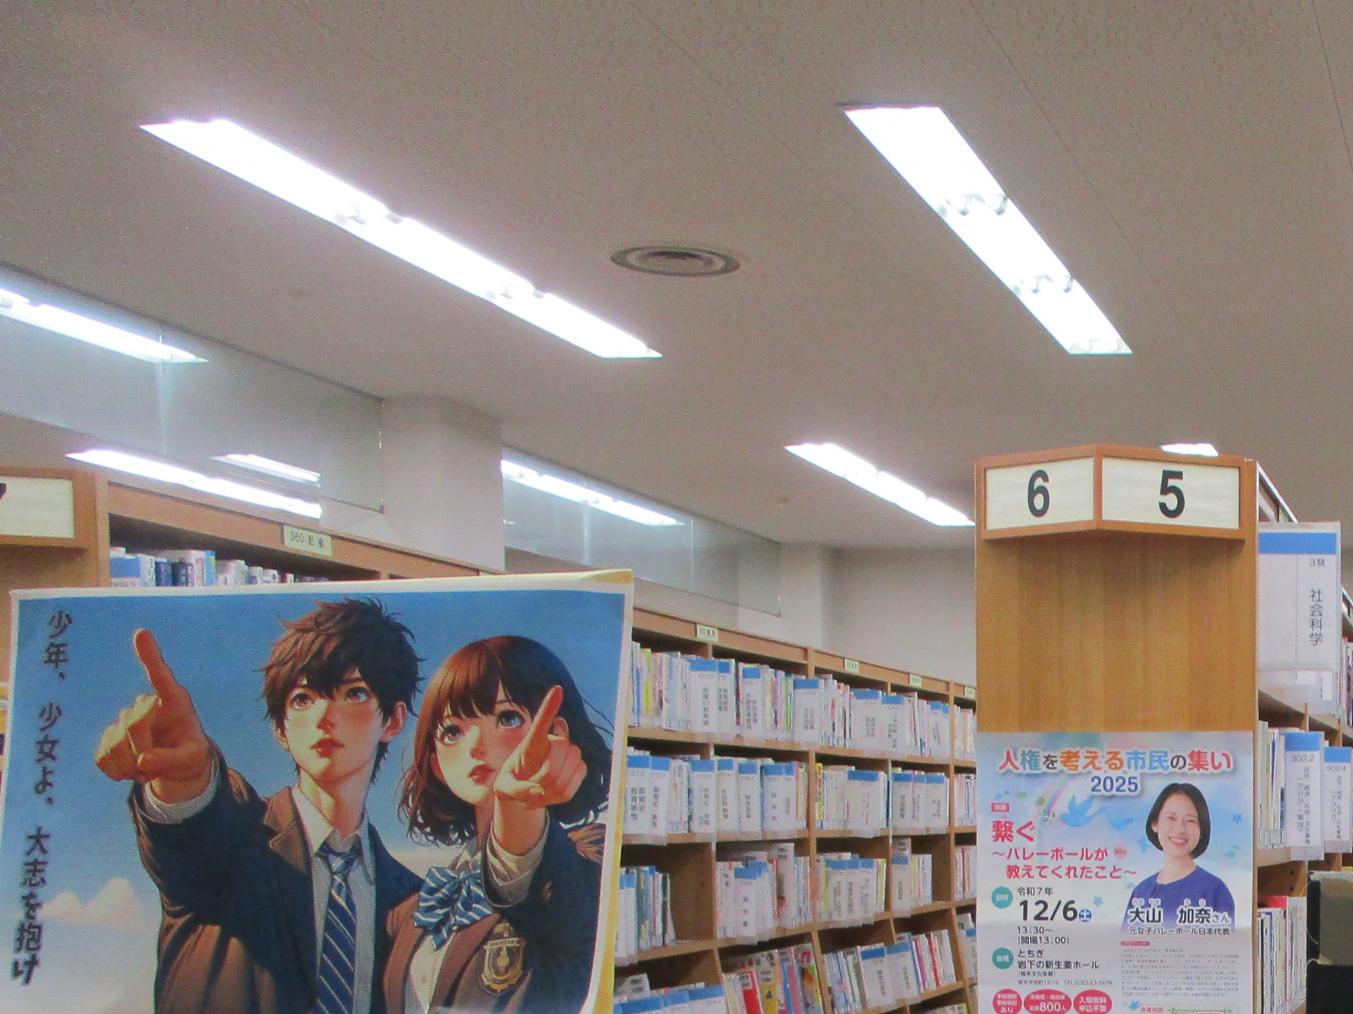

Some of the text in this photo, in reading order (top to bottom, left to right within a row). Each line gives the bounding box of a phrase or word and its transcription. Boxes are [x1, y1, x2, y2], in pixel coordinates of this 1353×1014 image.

[1027, 470, 1050, 518] 6
[1159, 470, 1185, 518] 5
[1309, 588, 1323, 646] 社会科学
[998, 750, 1232, 771] 人権を考える市民の集い
[1090, 776, 1139, 793] 2025
[11, 611, 72, 984] 少年、 少女よ、 大志を抱け
[992, 820, 1035, 842] 繋ぐ
[1130, 907, 1161, 923] 大山
[1130, 927, 1230, 935] 元女子バレーボール日本代表
[1018, 950, 1044, 958] とちぎ
